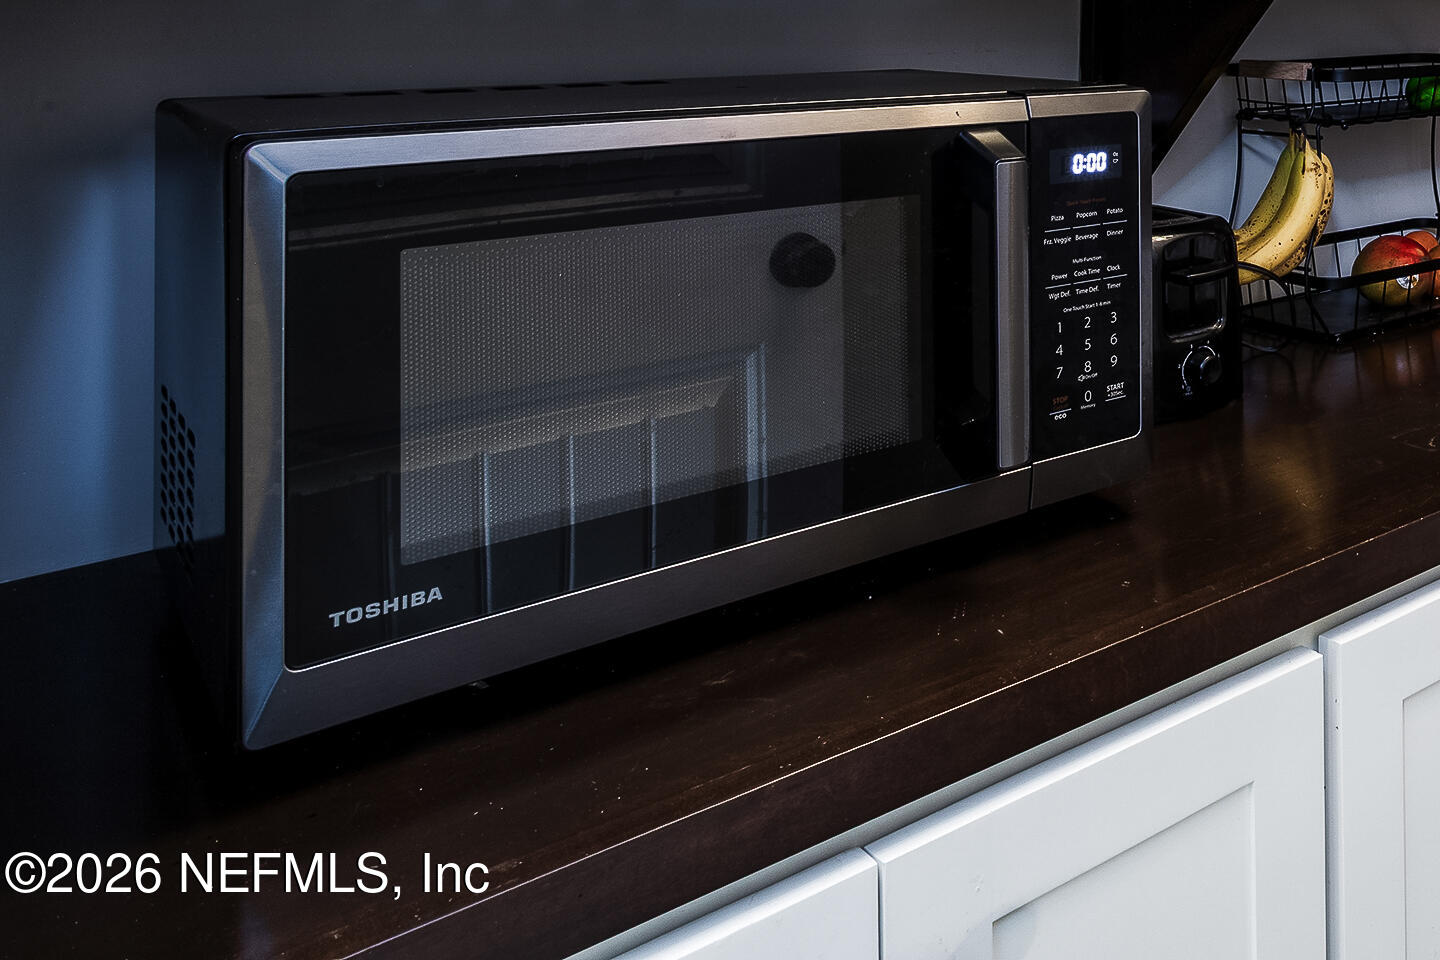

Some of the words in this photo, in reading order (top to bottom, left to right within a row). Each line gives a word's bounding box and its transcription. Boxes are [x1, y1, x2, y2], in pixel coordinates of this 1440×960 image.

[1072, 152, 1106, 175] 0:00
[1076, 211, 1097, 219] Popcorn
[1054, 236, 1071, 245] Veggie
[1075, 233, 1098, 241] Beverage
[1088, 268, 1100, 276] Time
[1107, 264, 1120, 272] Clock
[1061, 290, 1071, 298] Def.
[1076, 287, 1088, 295] Time
[1089, 285, 1099, 293] Def.
[1084, 316, 1091, 329] 2
[1110, 311, 1117, 323] 3
[1058, 321, 1062, 333] 1
[1084, 338, 1091, 351] 5
[1110, 333, 1117, 345] 6
[1056, 344, 1063, 356] 4
[1084, 360, 1091, 373] 8
[1110, 355, 1118, 367] 9
[1056, 366, 1063, 379] 7
[1107, 382, 1125, 392] START
[1053, 396, 1069, 405] STOP
[1084, 390, 1092, 402] 0
[329, 587, 443, 628] TOSHIBA
